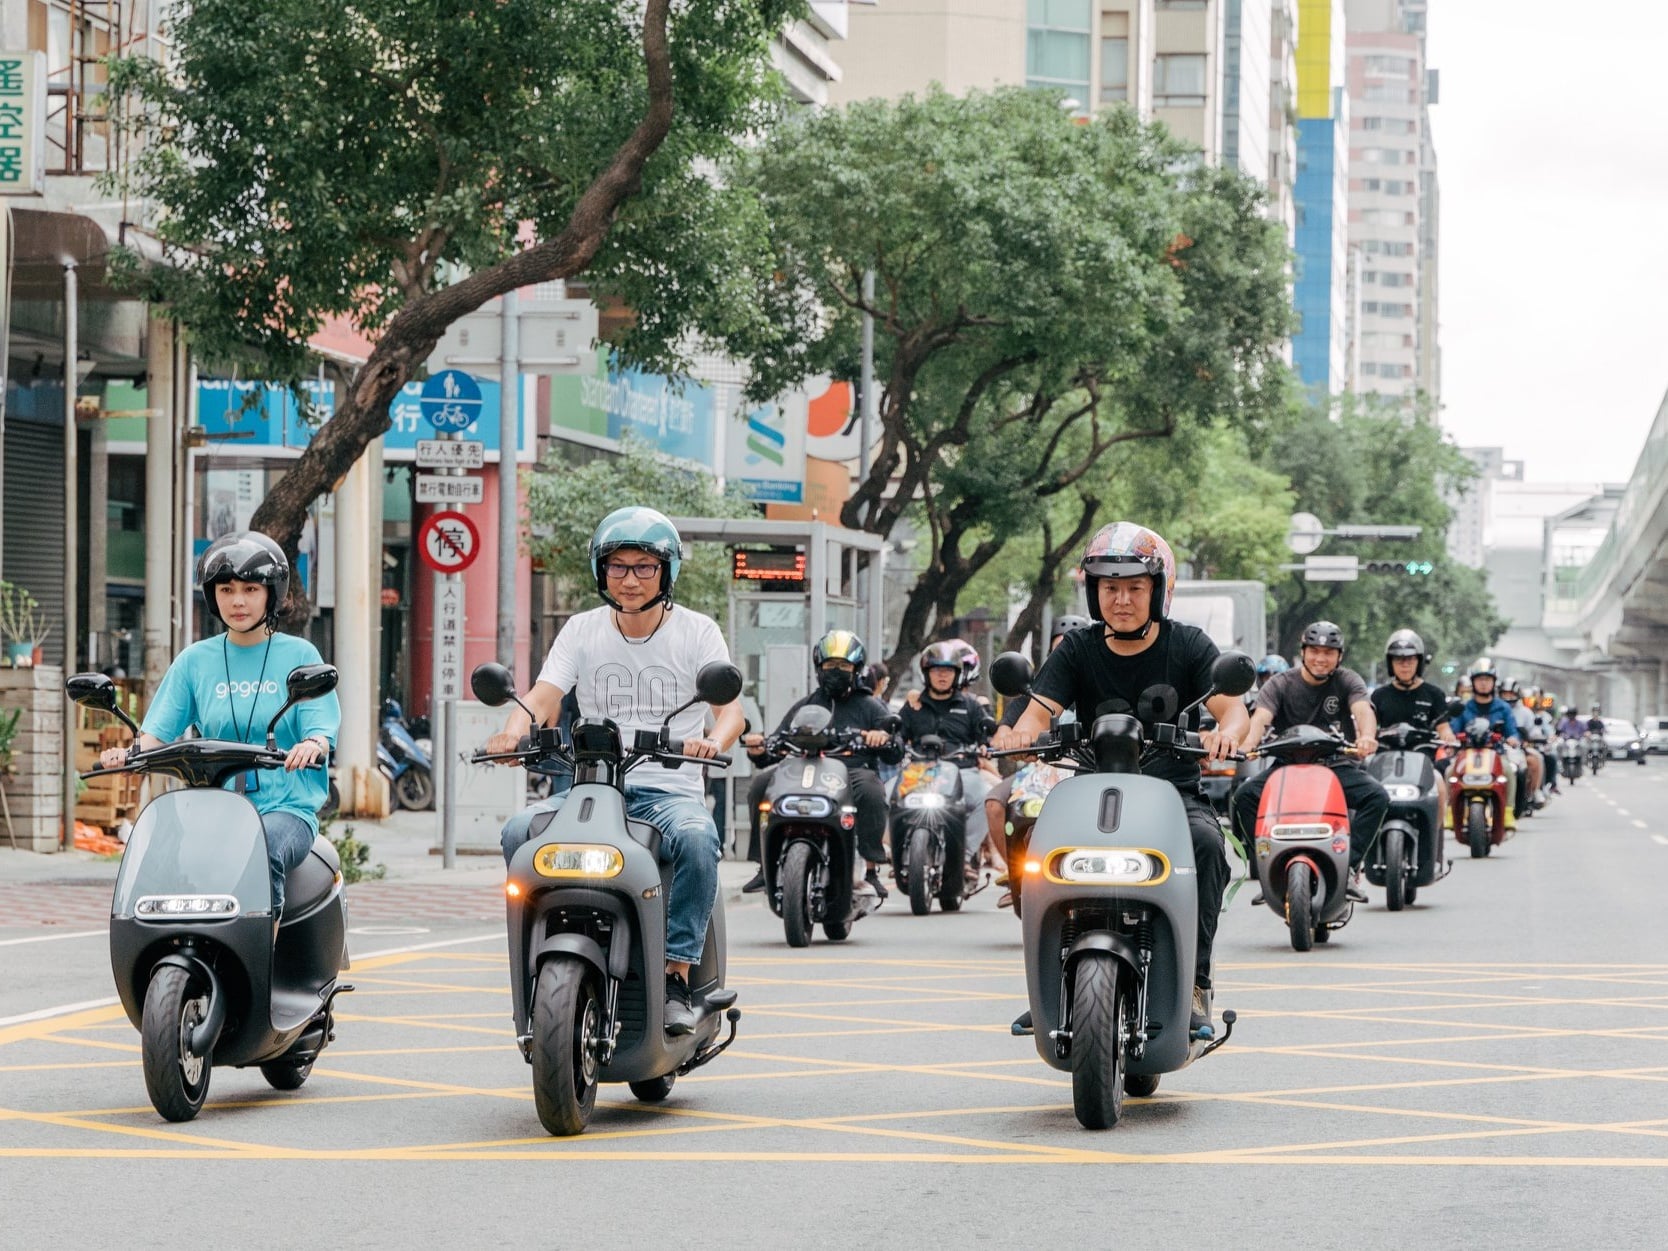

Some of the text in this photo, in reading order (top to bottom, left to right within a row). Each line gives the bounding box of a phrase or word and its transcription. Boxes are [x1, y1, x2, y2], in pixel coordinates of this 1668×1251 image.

[420, 443, 480, 457] 行人優先
[419, 482, 480, 497] 禁行電動自行車
[435, 527, 464, 558] 停
[441, 585, 457, 695] 人行道禁止停車
[216, 680, 278, 699] gogoro
[595, 662, 678, 726] GO
